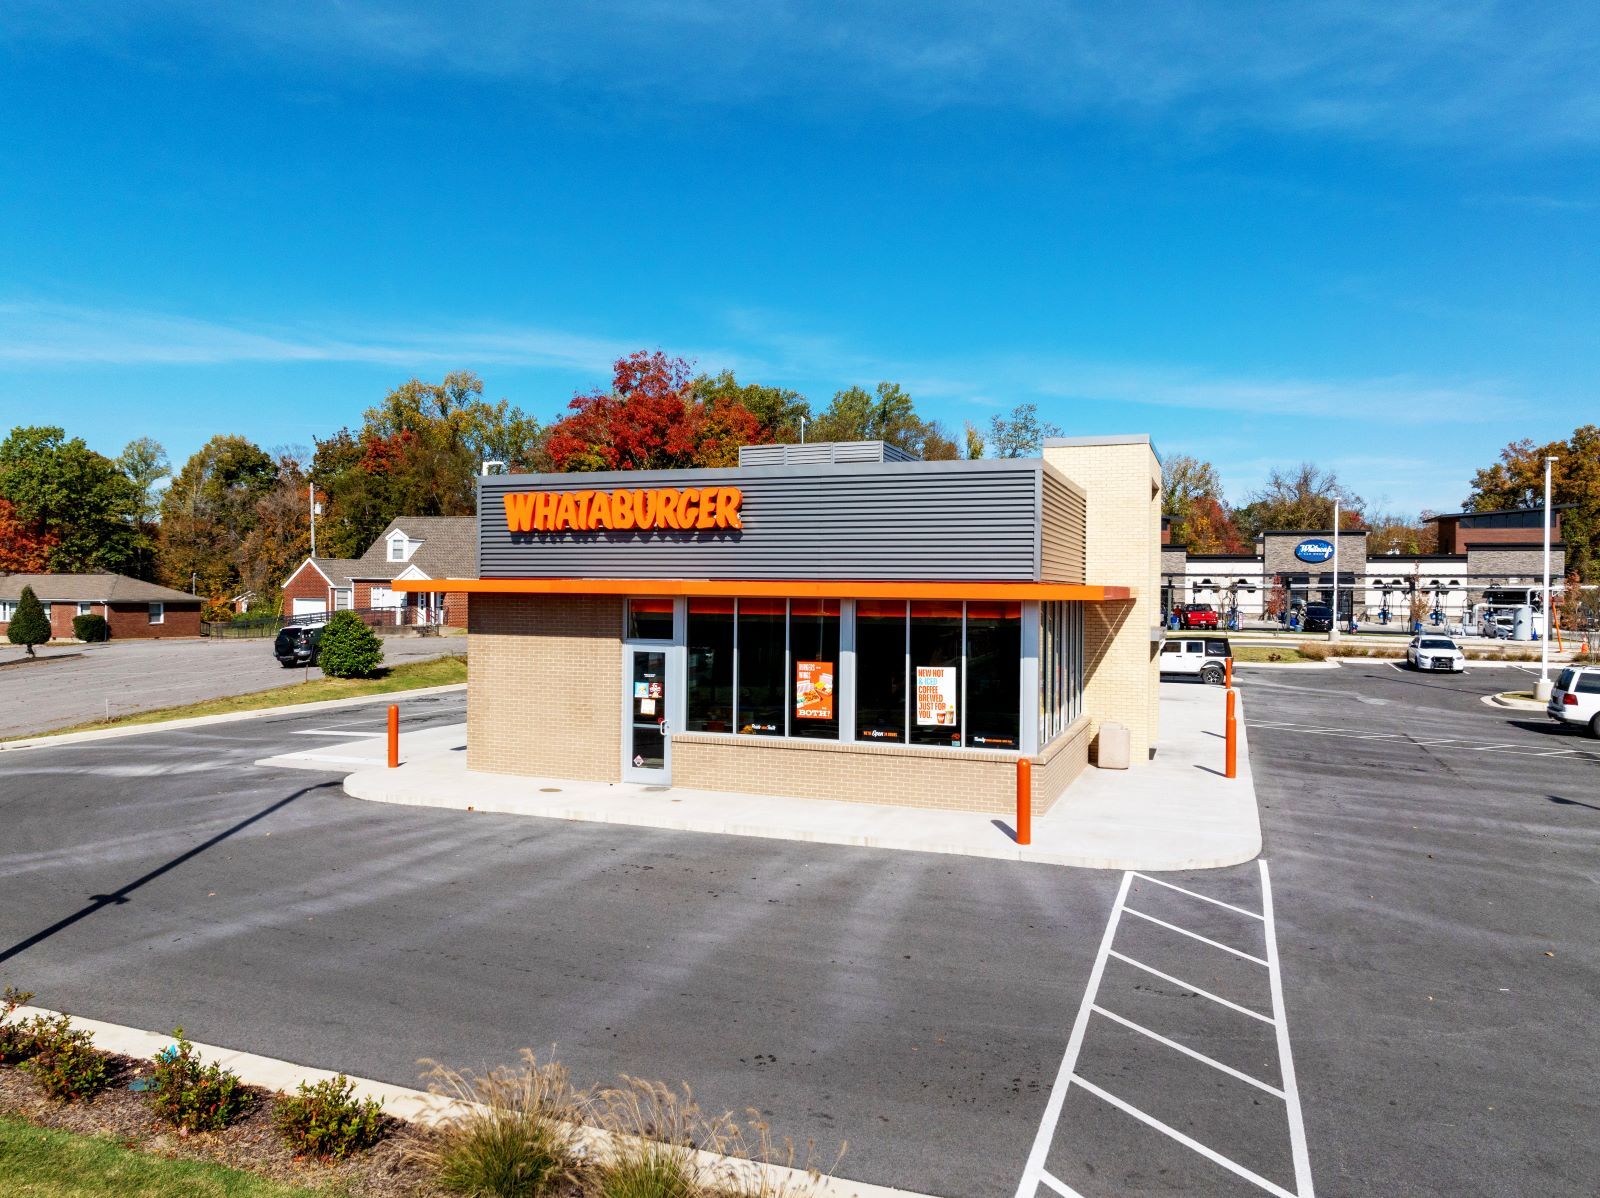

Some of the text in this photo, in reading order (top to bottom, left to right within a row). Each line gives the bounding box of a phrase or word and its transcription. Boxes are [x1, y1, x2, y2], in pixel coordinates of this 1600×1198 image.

[503, 487, 743, 531] WHATABURGER
[918, 669, 944, 677] NEW HOT
[918, 686, 938, 694] COFFEE
[918, 694, 943, 702] BREWED
[872, 730, 883, 738] Open
